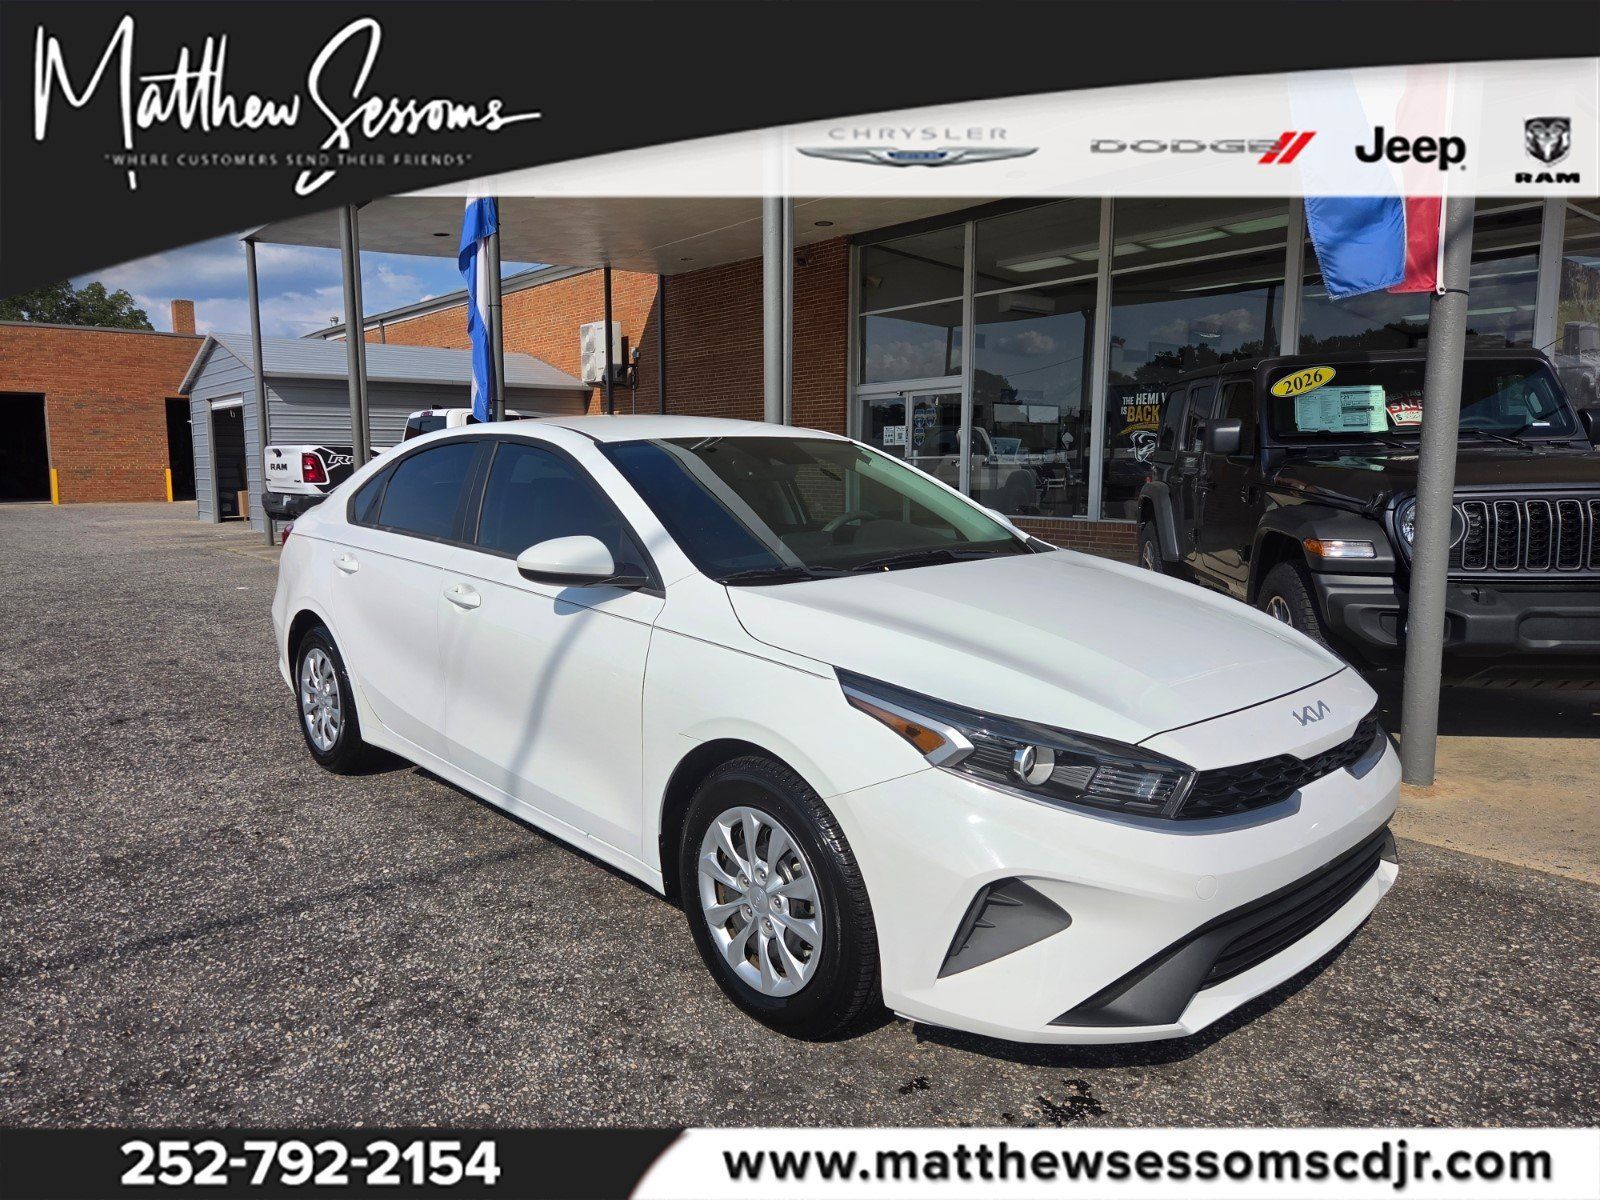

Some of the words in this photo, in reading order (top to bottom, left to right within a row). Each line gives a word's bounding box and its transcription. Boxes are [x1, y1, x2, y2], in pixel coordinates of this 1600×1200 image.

[1283, 373, 1323, 394] 2026
[1122, 396, 1135, 405] THE
[1135, 392, 1159, 405] HEMI
[1390, 400, 1423, 411] SALE
[1120, 407, 1127, 415] IS
[1127, 405, 1160, 422] BACK
[270, 463, 288, 471] RAM
[1292, 699, 1331, 727] KIA
